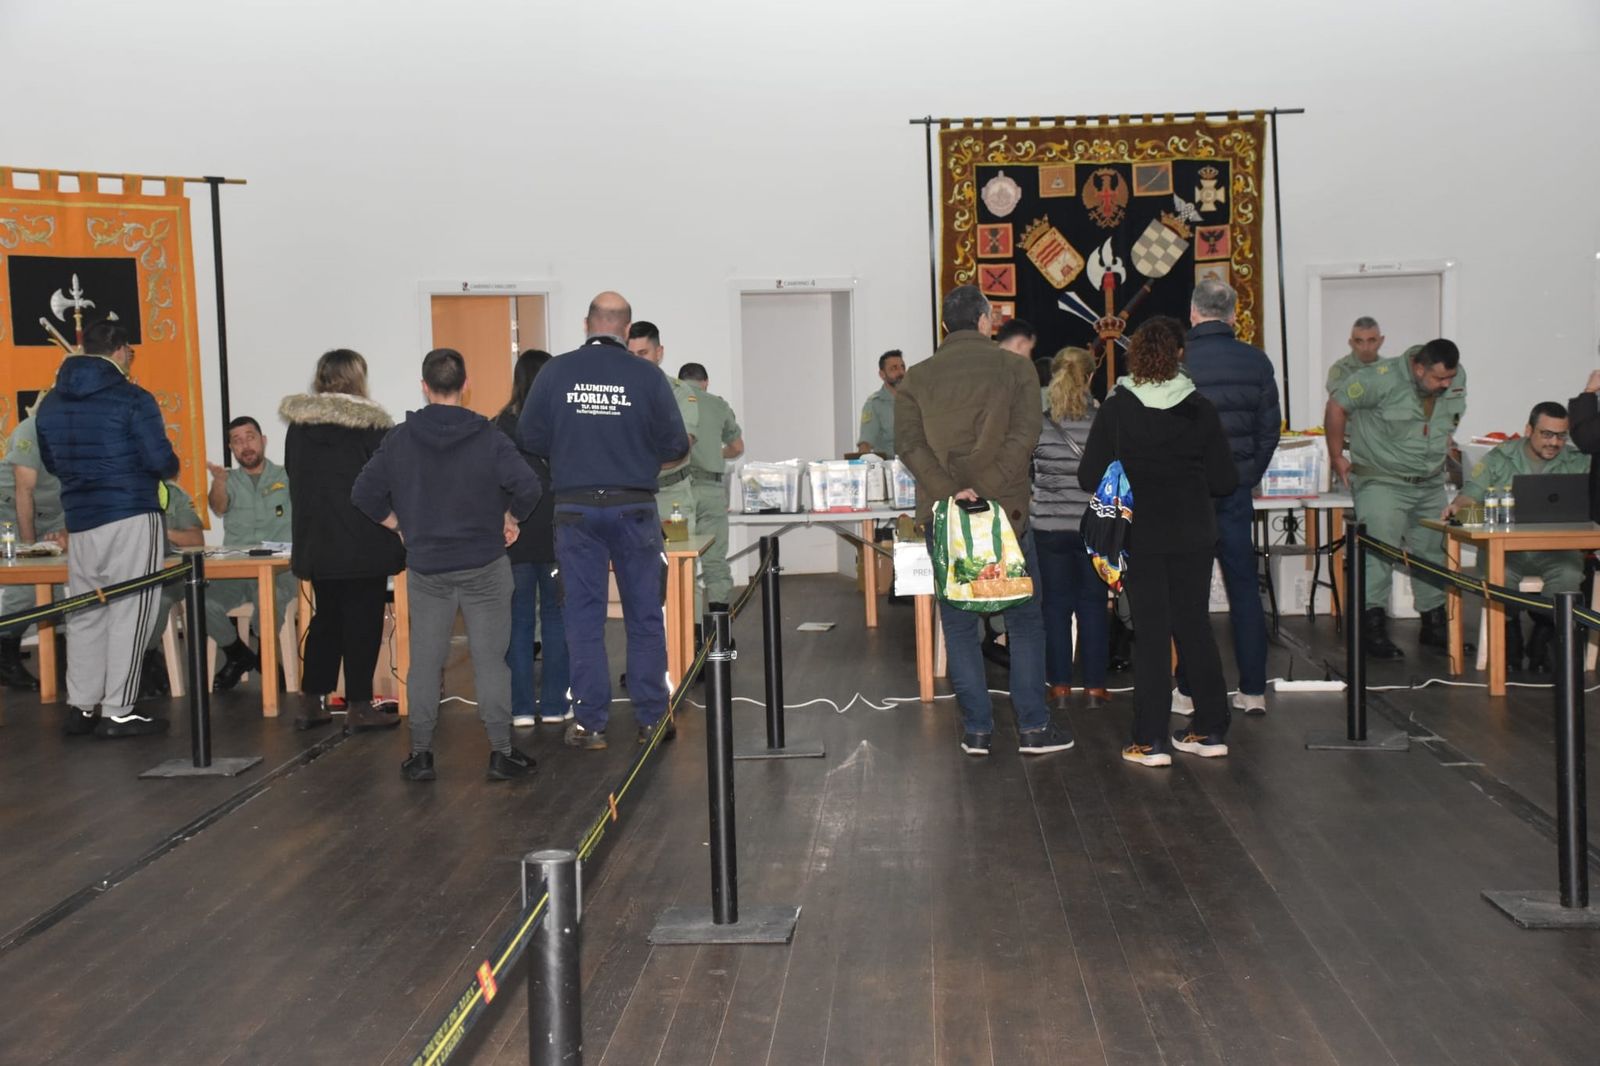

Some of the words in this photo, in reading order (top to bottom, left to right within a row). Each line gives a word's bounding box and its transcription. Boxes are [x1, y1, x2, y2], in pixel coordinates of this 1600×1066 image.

[574, 383, 625, 393] ALUMINIOS
[566, 392, 609, 404] FLORIA
[611, 394, 632, 406] S.L.
